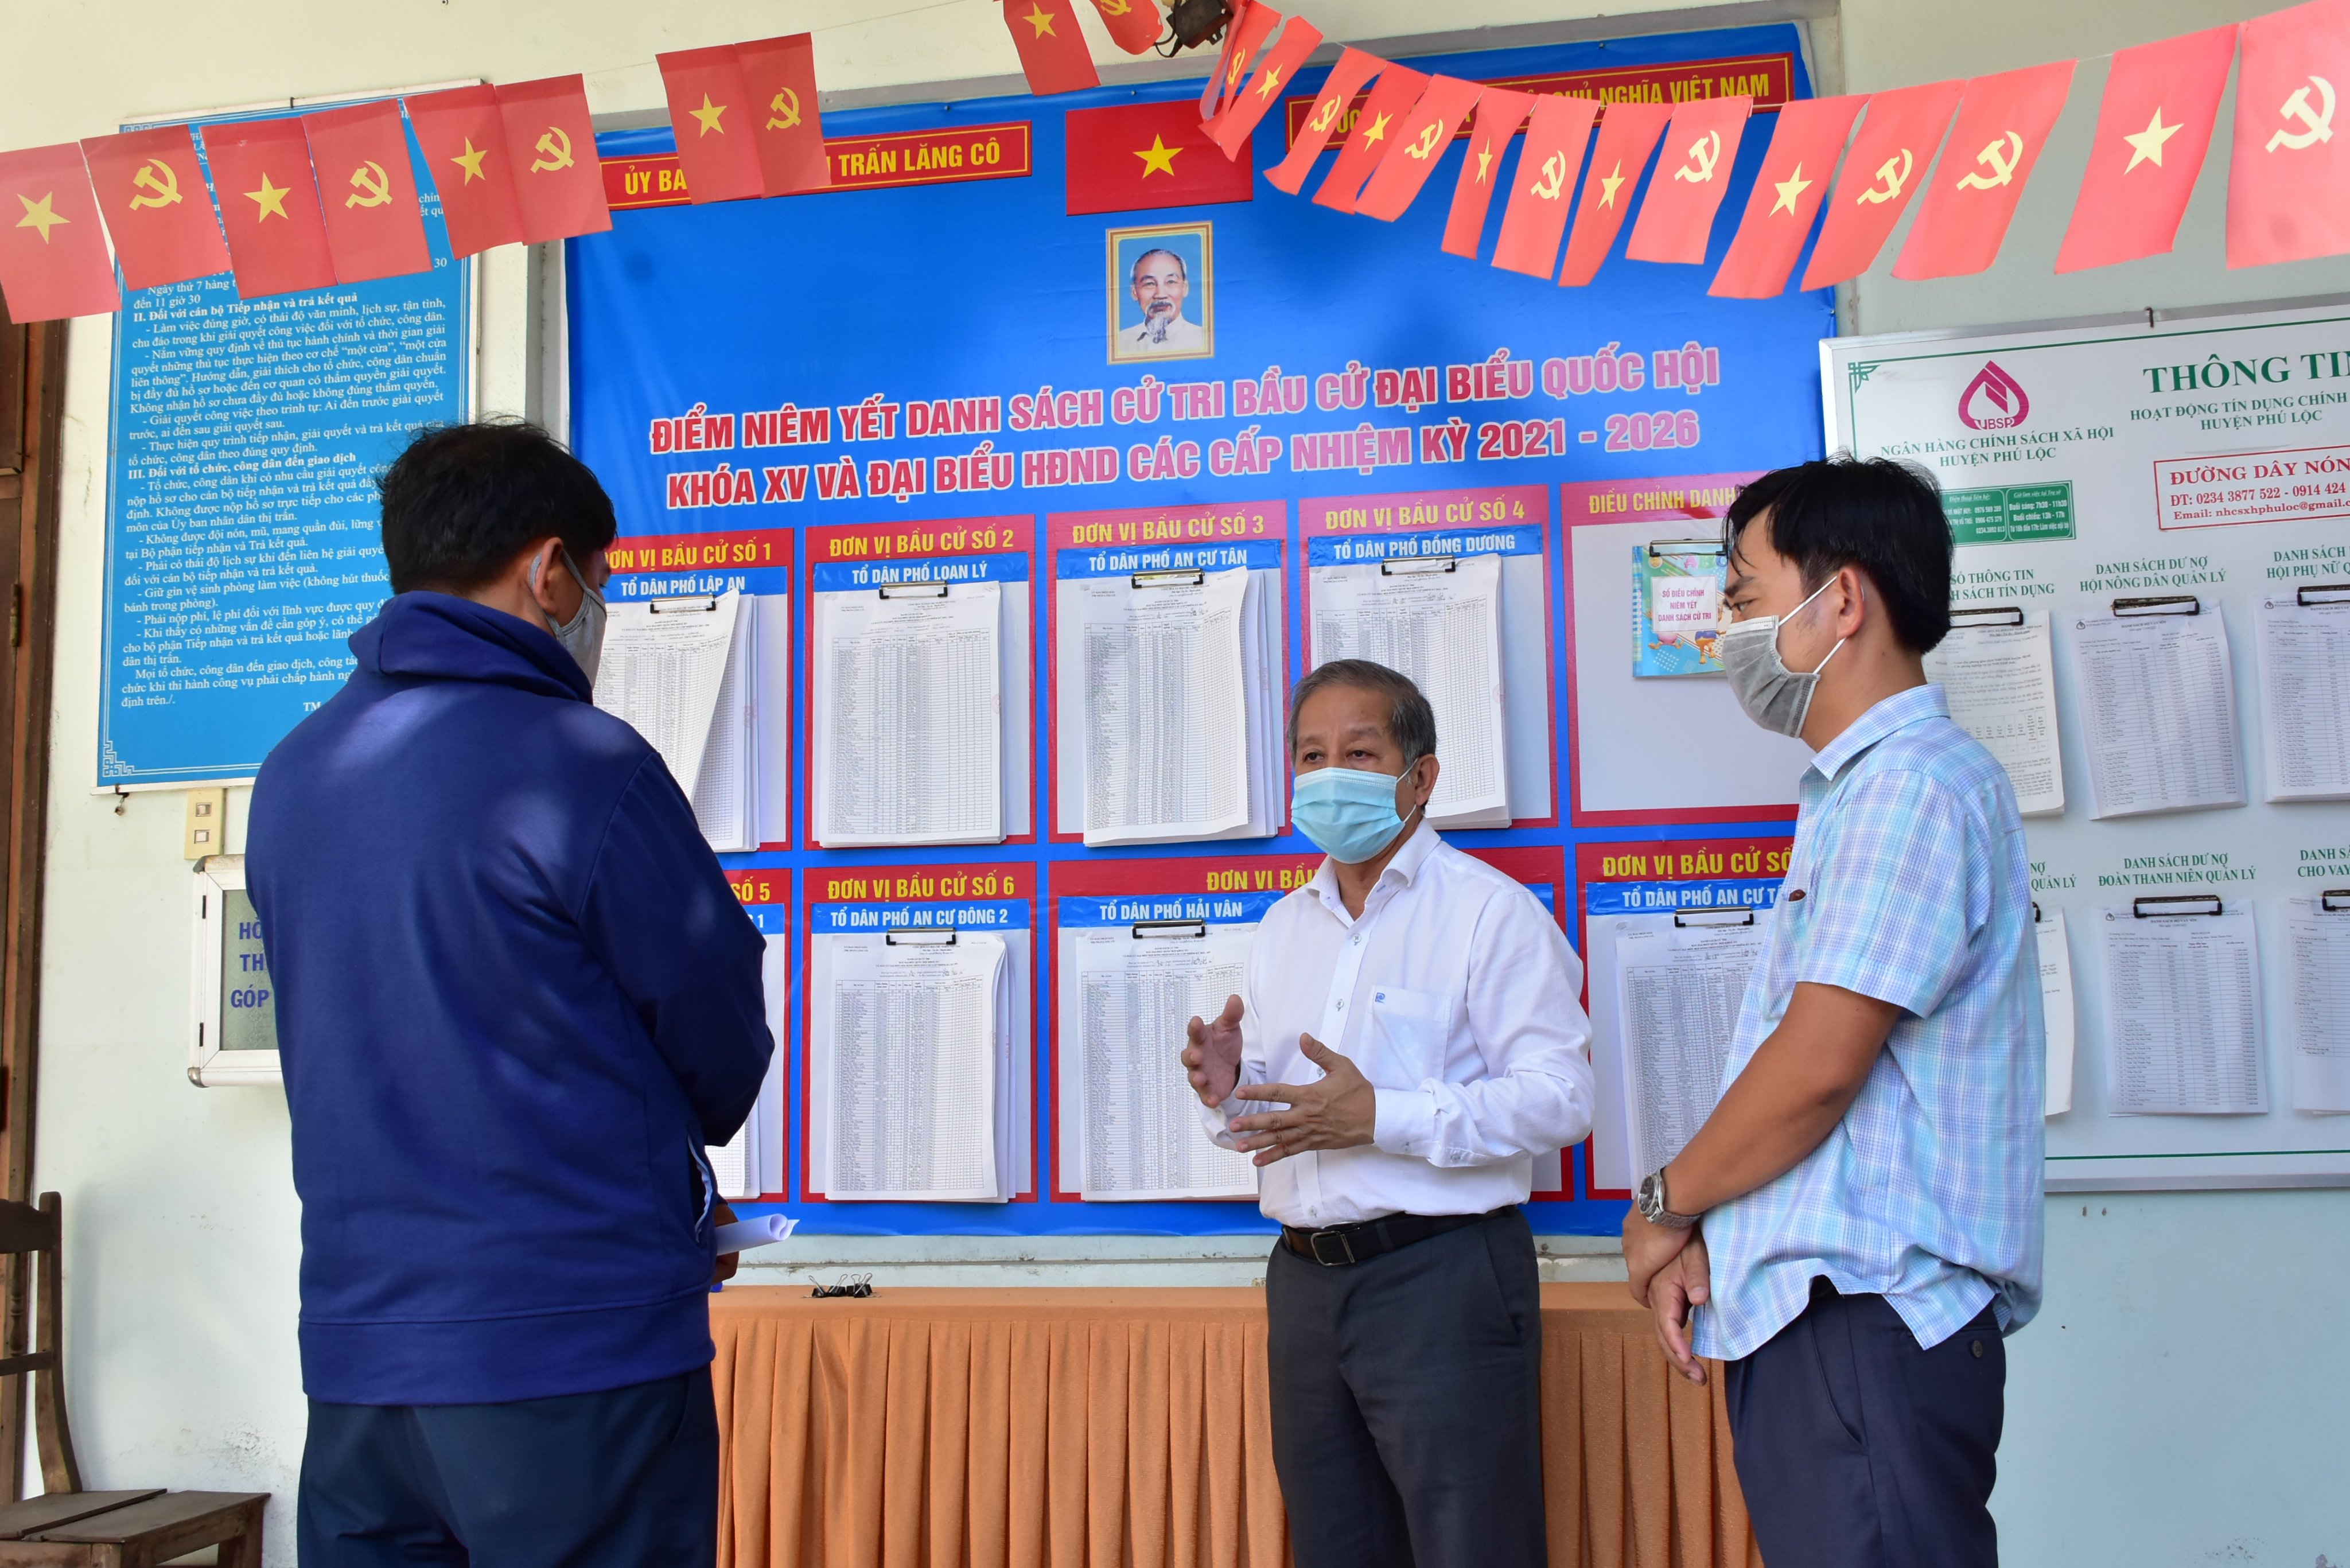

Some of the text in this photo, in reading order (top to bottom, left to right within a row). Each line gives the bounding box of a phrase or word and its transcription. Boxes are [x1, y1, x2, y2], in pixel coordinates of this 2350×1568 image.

[839, 143, 896, 177] TRẤN
[904, 142, 963, 172] LĂNG
[972, 138, 1001, 166] CÔ
[625, 165, 688, 195] ỦY BA
[134, 294, 200, 309] đến 11 giờ 30
[150, 309, 167, 320] Đối
[170, 309, 186, 318] với
[189, 308, 207, 317] cán
[211, 305, 224, 316] bộ
[227, 300, 250, 314] Tiếp
[254, 301, 280, 312] nhận
[283, 298, 295, 308] và
[299, 297, 314, 306] trả
[318, 293, 334, 305] kết
[337, 293, 357, 305] quả
[2143, 352, 2350, 392] THÔNG TI
[649, 341, 1720, 454] ĐIỂM NIÊM YẾT DANH SÁCH CỬ TRI BẦU CỬ ĐẠI BIỂU QUỐC HỘI
[2131, 391, 2347, 421] HOẠT ĐỘNG TÍN DỤNG CHÍNH
[1882, 426, 2114, 454] NGÂN HÀNG CHÍNH SÁCH XÃ HỘI
[129, 453, 356, 479] III. Đối với tổ chức, công dân đến giao dịch
[667, 463, 757, 509] KHÓA
[762, 465, 809, 503] XV
[814, 456, 861, 500] VÀ
[866, 458, 926, 503] ĐẠI
[934, 440, 1014, 493] BIỂU
[1022, 446, 1119, 488] HĐND
[1127, 435, 1201, 481] CÁC
[1208, 425, 1283, 477] CẤP
[1290, 422, 1412, 476] NHIỆM
[1420, 417, 1470, 464] KỲ
[1478, 418, 1566, 460] 2021
[1605, 409, 1701, 452] 2026
[1941, 447, 2056, 466] HUYỆN PHÚ LỘC
[2170, 456, 2350, 485] ĐƯỜNG DÂY NÓN
[1589, 485, 1737, 515] ĐIỀU CHỈNH DANH
[2170, 494, 2192, 506] ĐT:
[2196, 492, 2223, 504] 0234
[2228, 489, 2255, 501] 3877
[2260, 488, 2280, 499] 522
[2293, 484, 2320, 496] 0914
[2325, 482, 2345, 494] 424
[1073, 509, 1265, 544] ĐƠN VỊ BẦU CỬ SỐ 3
[830, 523, 1014, 558] ĐƠN VỊ BẦU CỬ SỐ 2
[1090, 547, 1247, 571] TỔ DÂN PHỐ AN CƯ TÂN
[2096, 556, 2207, 574] DANH SÁCH DƯ NỢ
[853, 561, 987, 584] TỔ DÂN PHỐ LOAN LÝ
[2080, 569, 2226, 593] HỘI NÔNG DÂN QUẢN LÝ
[121, 697, 143, 708] định
[2125, 853, 2227, 869] DANH SÁCH DƯ NỢ
[2099, 866, 2255, 886] ĐOÀN THANH NIÊN QUẢN LÝ
[831, 906, 1007, 926] TỔ DÂN PHỐ AN CƯ ĐÔNG 2
[231, 984, 270, 1008] GÓP
